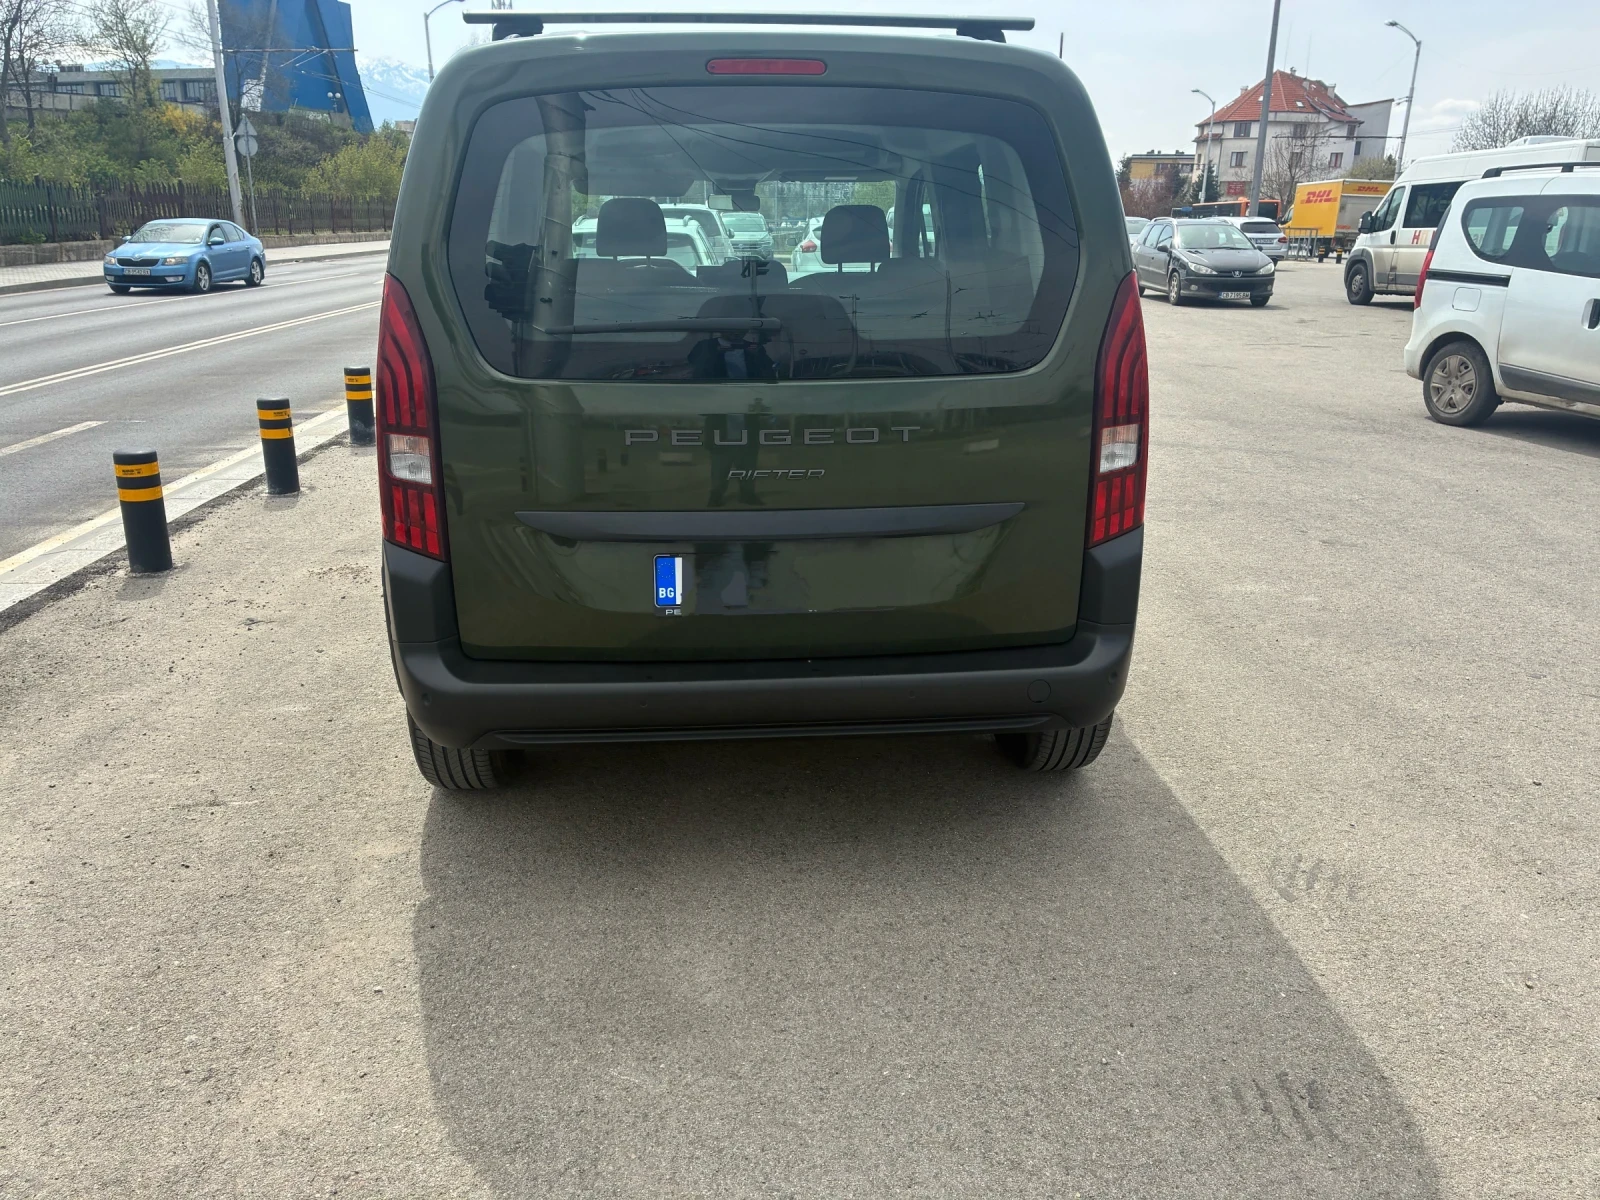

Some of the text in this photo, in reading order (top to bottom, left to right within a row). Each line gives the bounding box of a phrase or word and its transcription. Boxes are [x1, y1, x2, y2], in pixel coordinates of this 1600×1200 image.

[1305, 190, 1333, 204] DHL
[624, 426, 920, 446] PEUGEOT
[727, 469, 826, 480] RIFTER
[658, 587, 675, 598] BG
